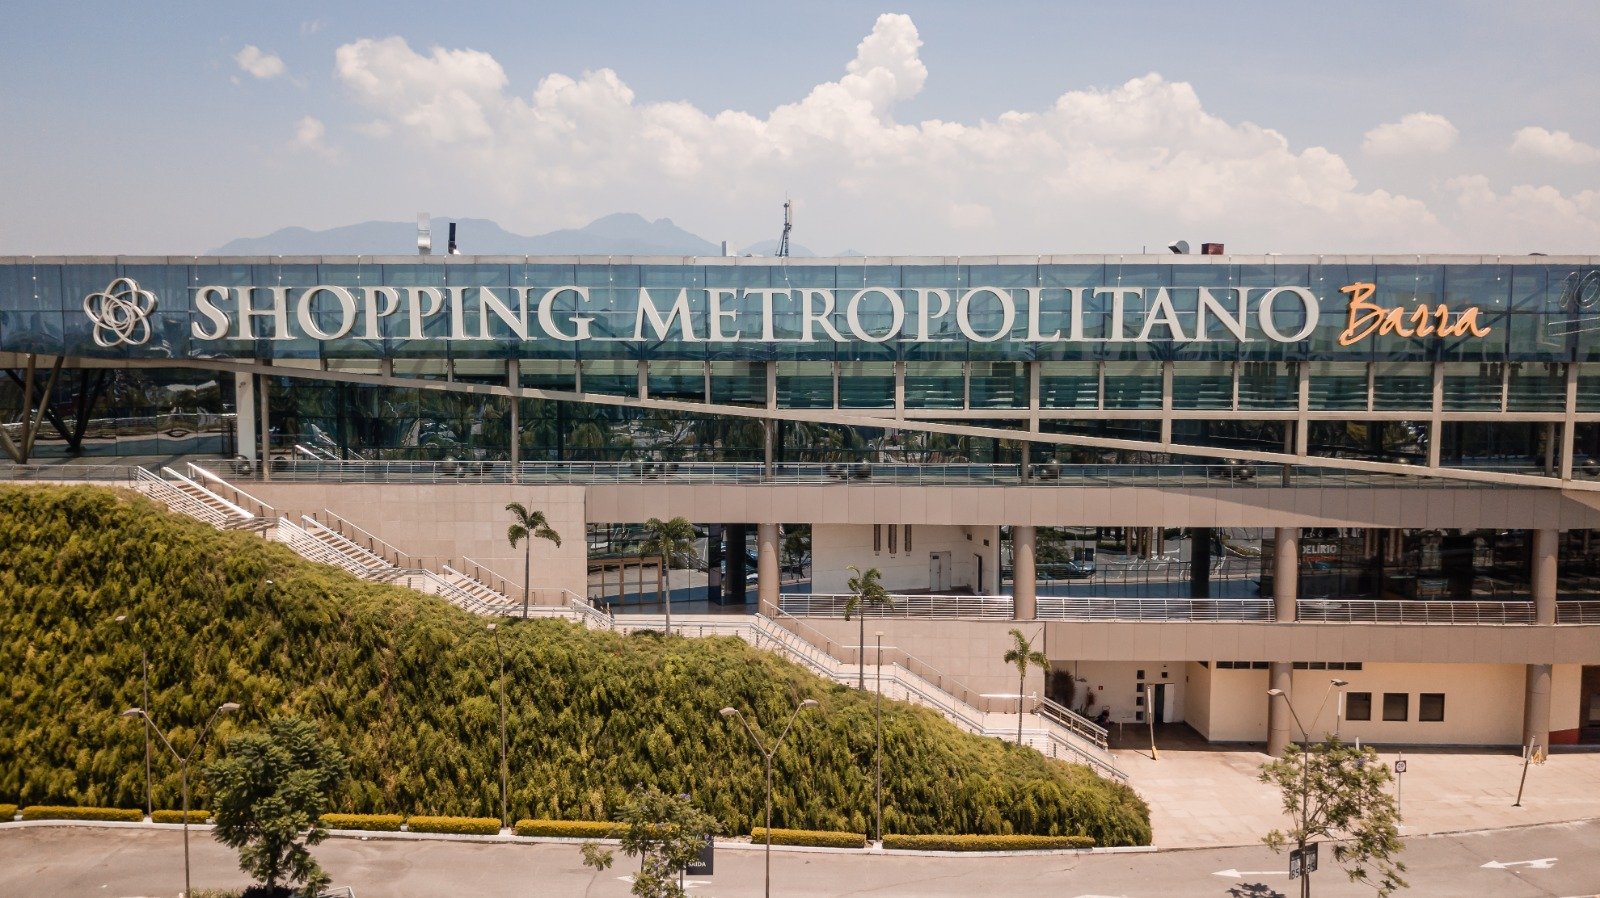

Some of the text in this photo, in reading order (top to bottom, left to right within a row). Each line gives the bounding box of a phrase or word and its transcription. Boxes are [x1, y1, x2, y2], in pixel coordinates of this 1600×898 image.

[191, 281, 1492, 346] SHOPPING METROPOLITANO Barra
